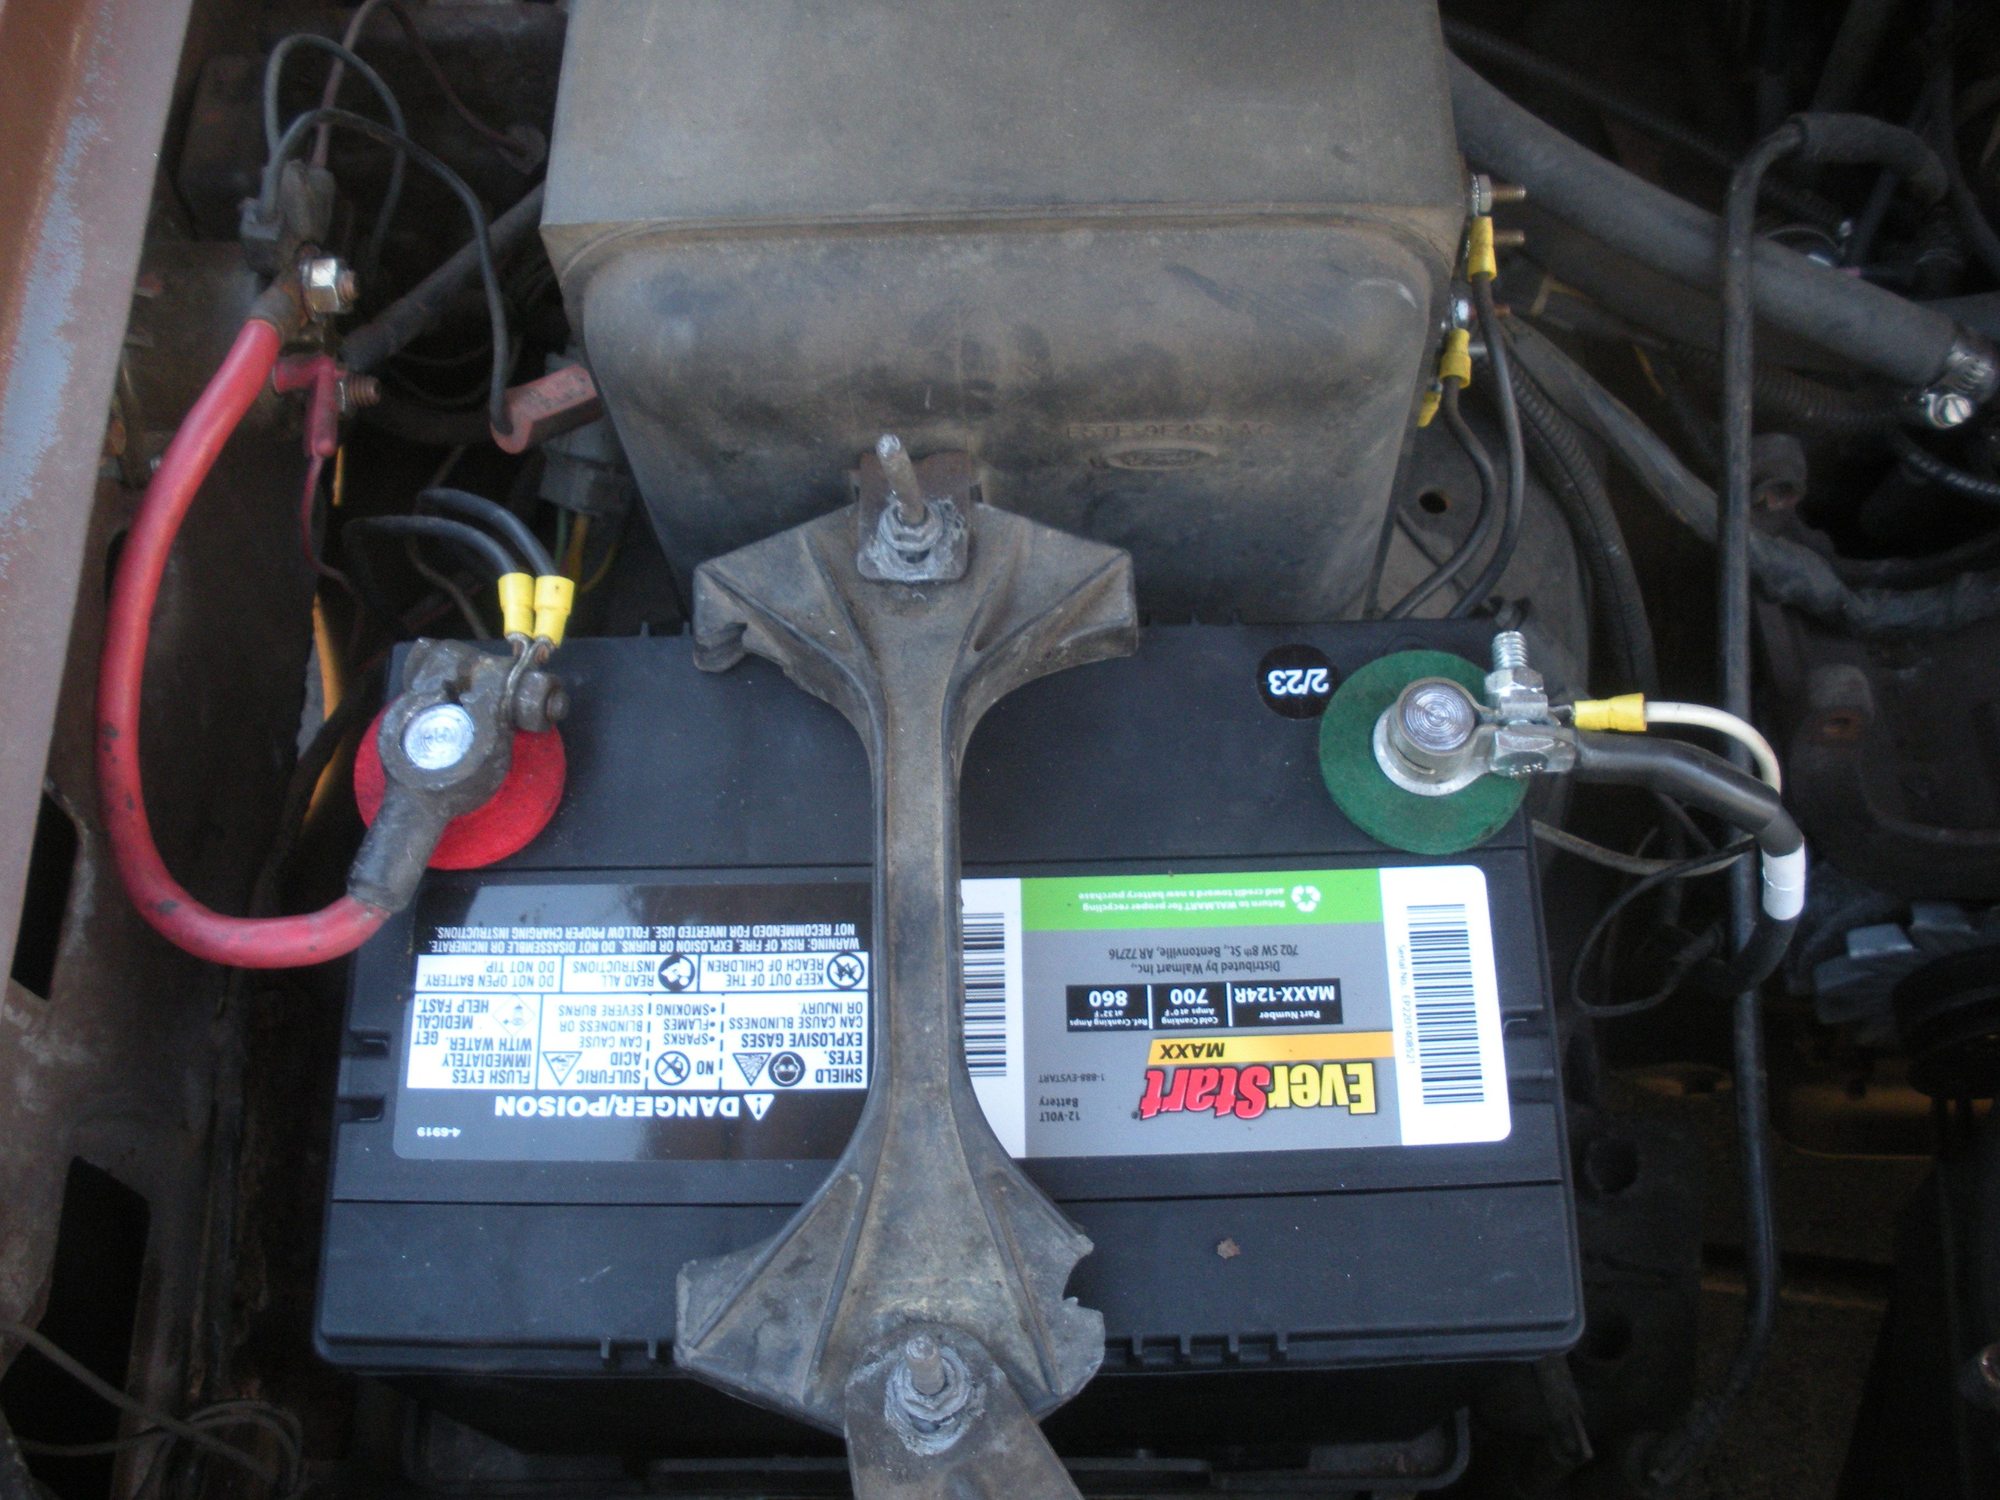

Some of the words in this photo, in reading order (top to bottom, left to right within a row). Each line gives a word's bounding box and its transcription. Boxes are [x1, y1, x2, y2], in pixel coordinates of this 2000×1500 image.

[1268, 668, 1329, 695] 2/23
[435, 927, 509, 939] INSTRUCTIONS.
[512, 927, 563, 939] CHARGING
[566, 926, 605, 938] PROPER
[608, 926, 649, 938] FOLLOW
[653, 926, 675, 938] USE.
[679, 926, 726, 938] INVERTED
[730, 925, 750, 937] FOR
[753, 924, 831, 937] RECOMMENDED
[835, 923, 855, 936] NOT
[429, 941, 488, 952] INCINERATE.
[491, 941, 504, 952] OR
[508, 941, 576, 952] DISASSEMBLE
[579, 941, 598, 952] NOT
[601, 940, 615, 952] DO
[620, 940, 656, 952] BURNS.
[660, 940, 673, 952] OR
[677, 940, 733, 952] EXPLOSION
[736, 939, 762, 951] FIRE,
[765, 939, 777, 951] OF
[781, 939, 804, 951] RISK
[807, 937, 859, 950] WARNING:
[1109, 948, 1137, 960] 72716
[1139, 948, 1153, 959] AR
[1156, 946, 1221, 959] Bentonville,
[1261, 945, 1278, 957] SW
[1280, 944, 1298, 956] 702
[510, 961, 533, 973] NOT
[538, 961, 555, 973] DO
[768, 959, 782, 972] OF
[787, 958, 824, 971] REACH
[1156, 962, 1203, 975] Walmart
[1206, 961, 1218, 975] by
[1221, 960, 1280, 973] Distributed
[423, 974, 474, 987] BATTERY.
[478, 975, 507, 987] OPEN
[512, 975, 533, 987] NOT
[537, 975, 554, 987] DO
[602, 975, 620, 987] ALL
[625, 975, 655, 987] READ
[726, 975, 746, 987] THE
[751, 974, 765, 987] OF
[770, 974, 791, 986] OUT
[795, 973, 824, 985] KEEP
[1089, 990, 1128, 1007] 860
[1170, 988, 1208, 1004] 700
[1234, 985, 1335, 1003] MAXX-124R
[418, 999, 452, 1013] FAST.
[456, 999, 489, 1013] HELP
[599, 1004, 644, 1016] SEVERE
[847, 1002, 863, 1013] OR
[1191, 1007, 1214, 1015] Amps
[1161, 1016, 1198, 1025] Cranking
[1259, 1011, 1298, 1019] Number
[1300, 1010, 1320, 1019] Part
[416, 1015, 473, 1029] MEDICAL
[559, 1021, 575, 1032] OR
[579, 1020, 643, 1032] BLINDNESS
[729, 1017, 794, 1029] BLINDNESS
[798, 1016, 836, 1029] CAUSE
[840, 1016, 863, 1028] CAN
[1094, 1018, 1131, 1026] Cranking
[414, 1031, 439, 1045] GET
[445, 1037, 494, 1051] WATER.
[498, 1037, 532, 1051] WITH
[579, 1036, 615, 1048] CAUSE
[618, 1036, 642, 1048] CAN
[741, 1033, 784, 1048] GASES
[789, 1032, 863, 1047] EXPLOSIVE
[1159, 1042, 1225, 1059] MAXX
[442, 1053, 531, 1067] IMMEDIATELY
[610, 1052, 641, 1066] ACID
[824, 1050, 863, 1065] EYES.
[697, 1061, 714, 1075] NO
[452, 1070, 484, 1083] EYES
[489, 1070, 530, 1084] FLUSH
[576, 1070, 641, 1084] SULFURIC
[815, 1068, 863, 1083] SHIELD
[1038, 1073, 1104, 1082] 1-888-EVSTART
[1139, 1062, 1377, 1120] EverStart
[494, 1094, 740, 1118] DANGER/POISON
[1039, 1096, 1078, 1108] Battery
[1040, 1111, 1080, 1121] 12-VOLT
[416, 1127, 461, 1137] 4-6919
